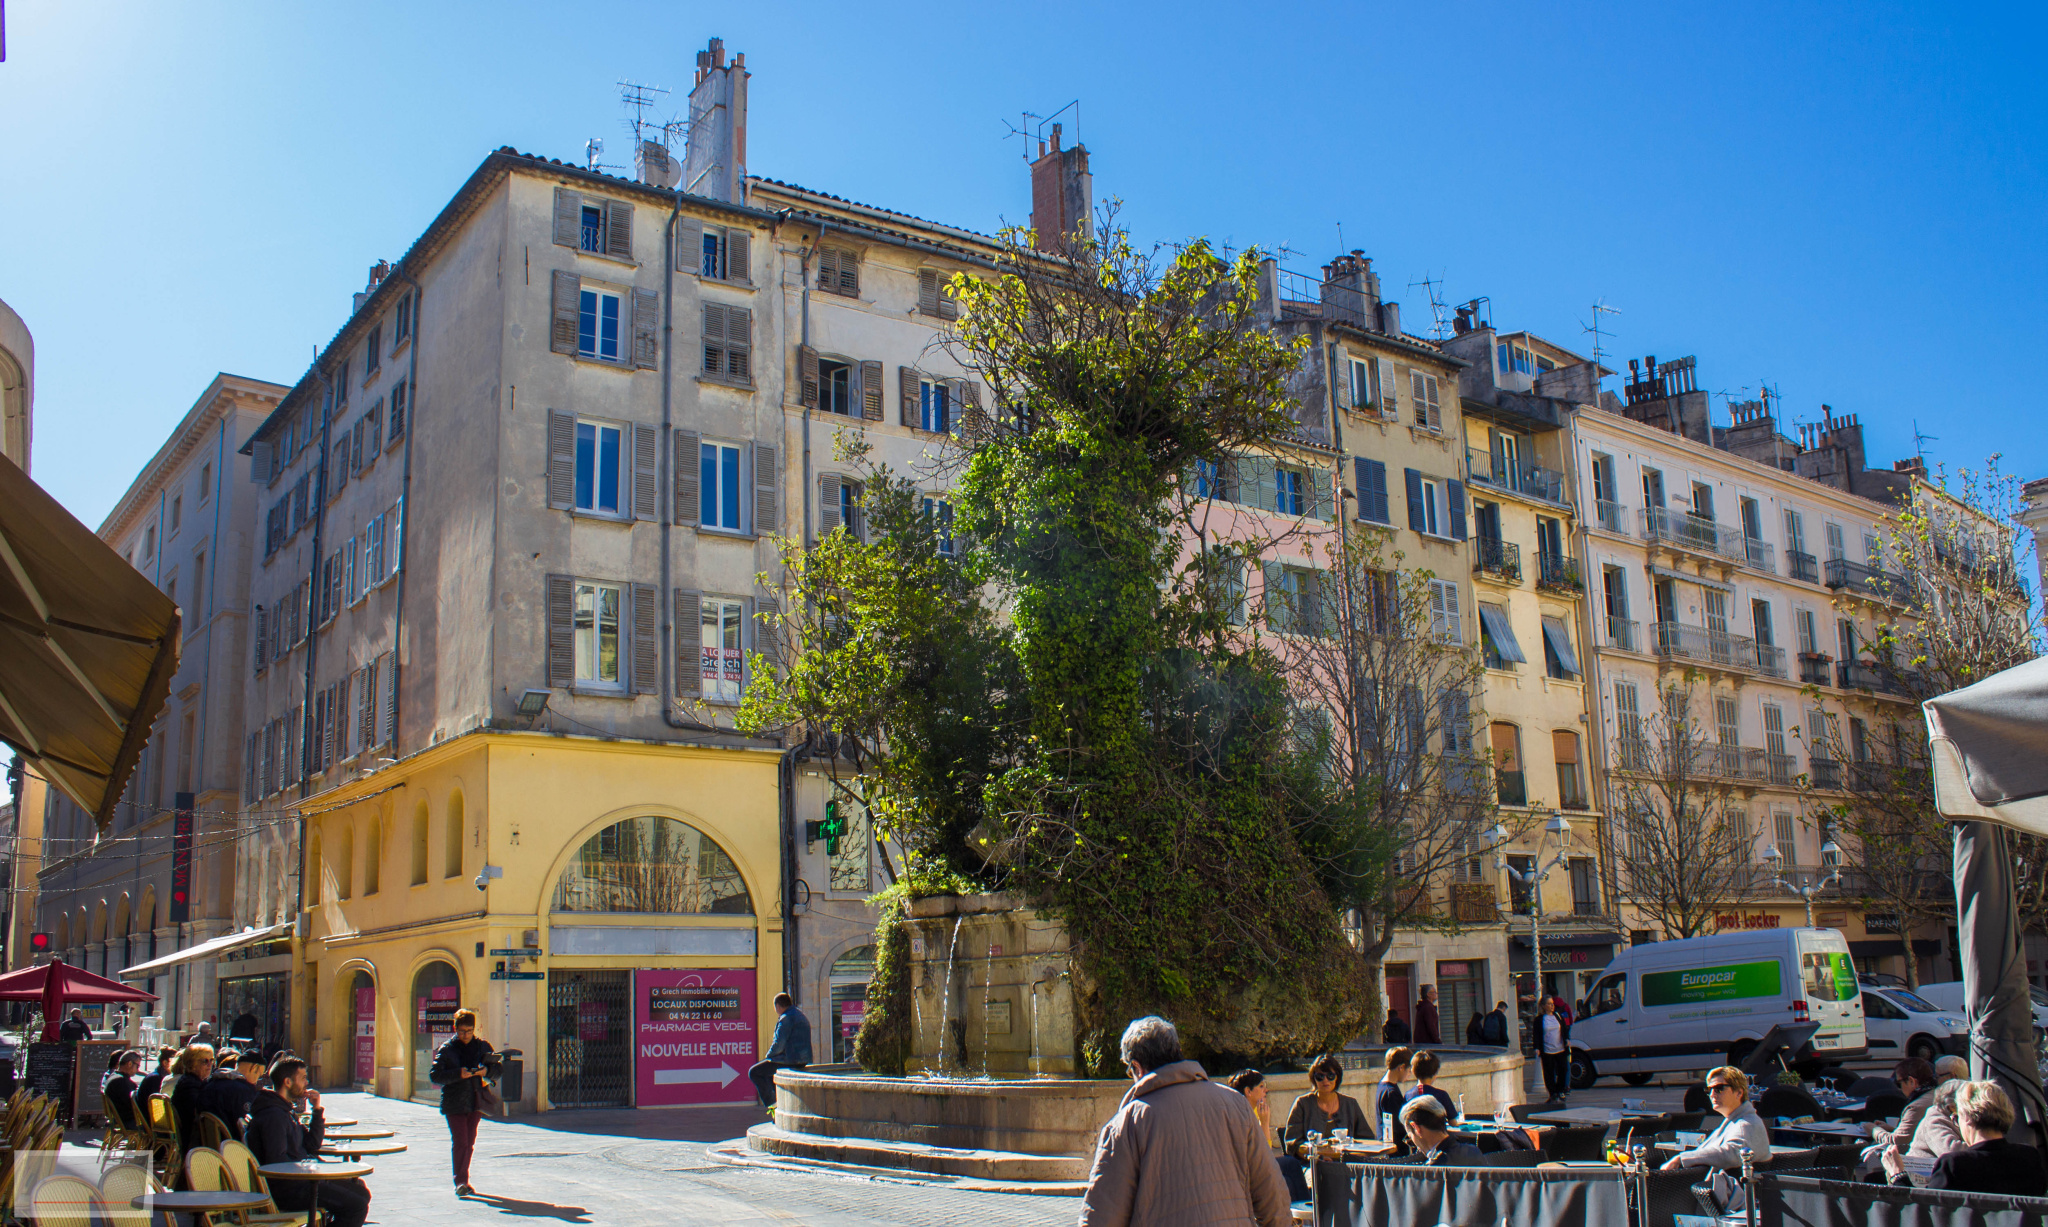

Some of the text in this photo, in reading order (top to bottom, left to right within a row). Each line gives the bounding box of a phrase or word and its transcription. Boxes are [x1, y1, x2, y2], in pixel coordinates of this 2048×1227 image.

[174, 807, 190, 887] MONOPRIX
[1743, 909, 1780, 928] Locker
[1541, 947, 1588, 964] Steverline
[1681, 970, 1737, 987] Europcar
[661, 987, 680, 995] Grech
[680, 987, 711, 995] Immobilier
[711, 987, 739, 996] Entreprise
[1681, 990, 1705, 998] moving
[1722, 988, 1737, 996] way
[653, 1000, 738, 1009] LOCAUX DISPONIBLES
[669, 1012, 722, 1020] 04 94 22 16 60
[641, 1021, 752, 1033] PHARMACIE VEDEL
[641, 1041, 752, 1057] NOUVELLE ENTREE
